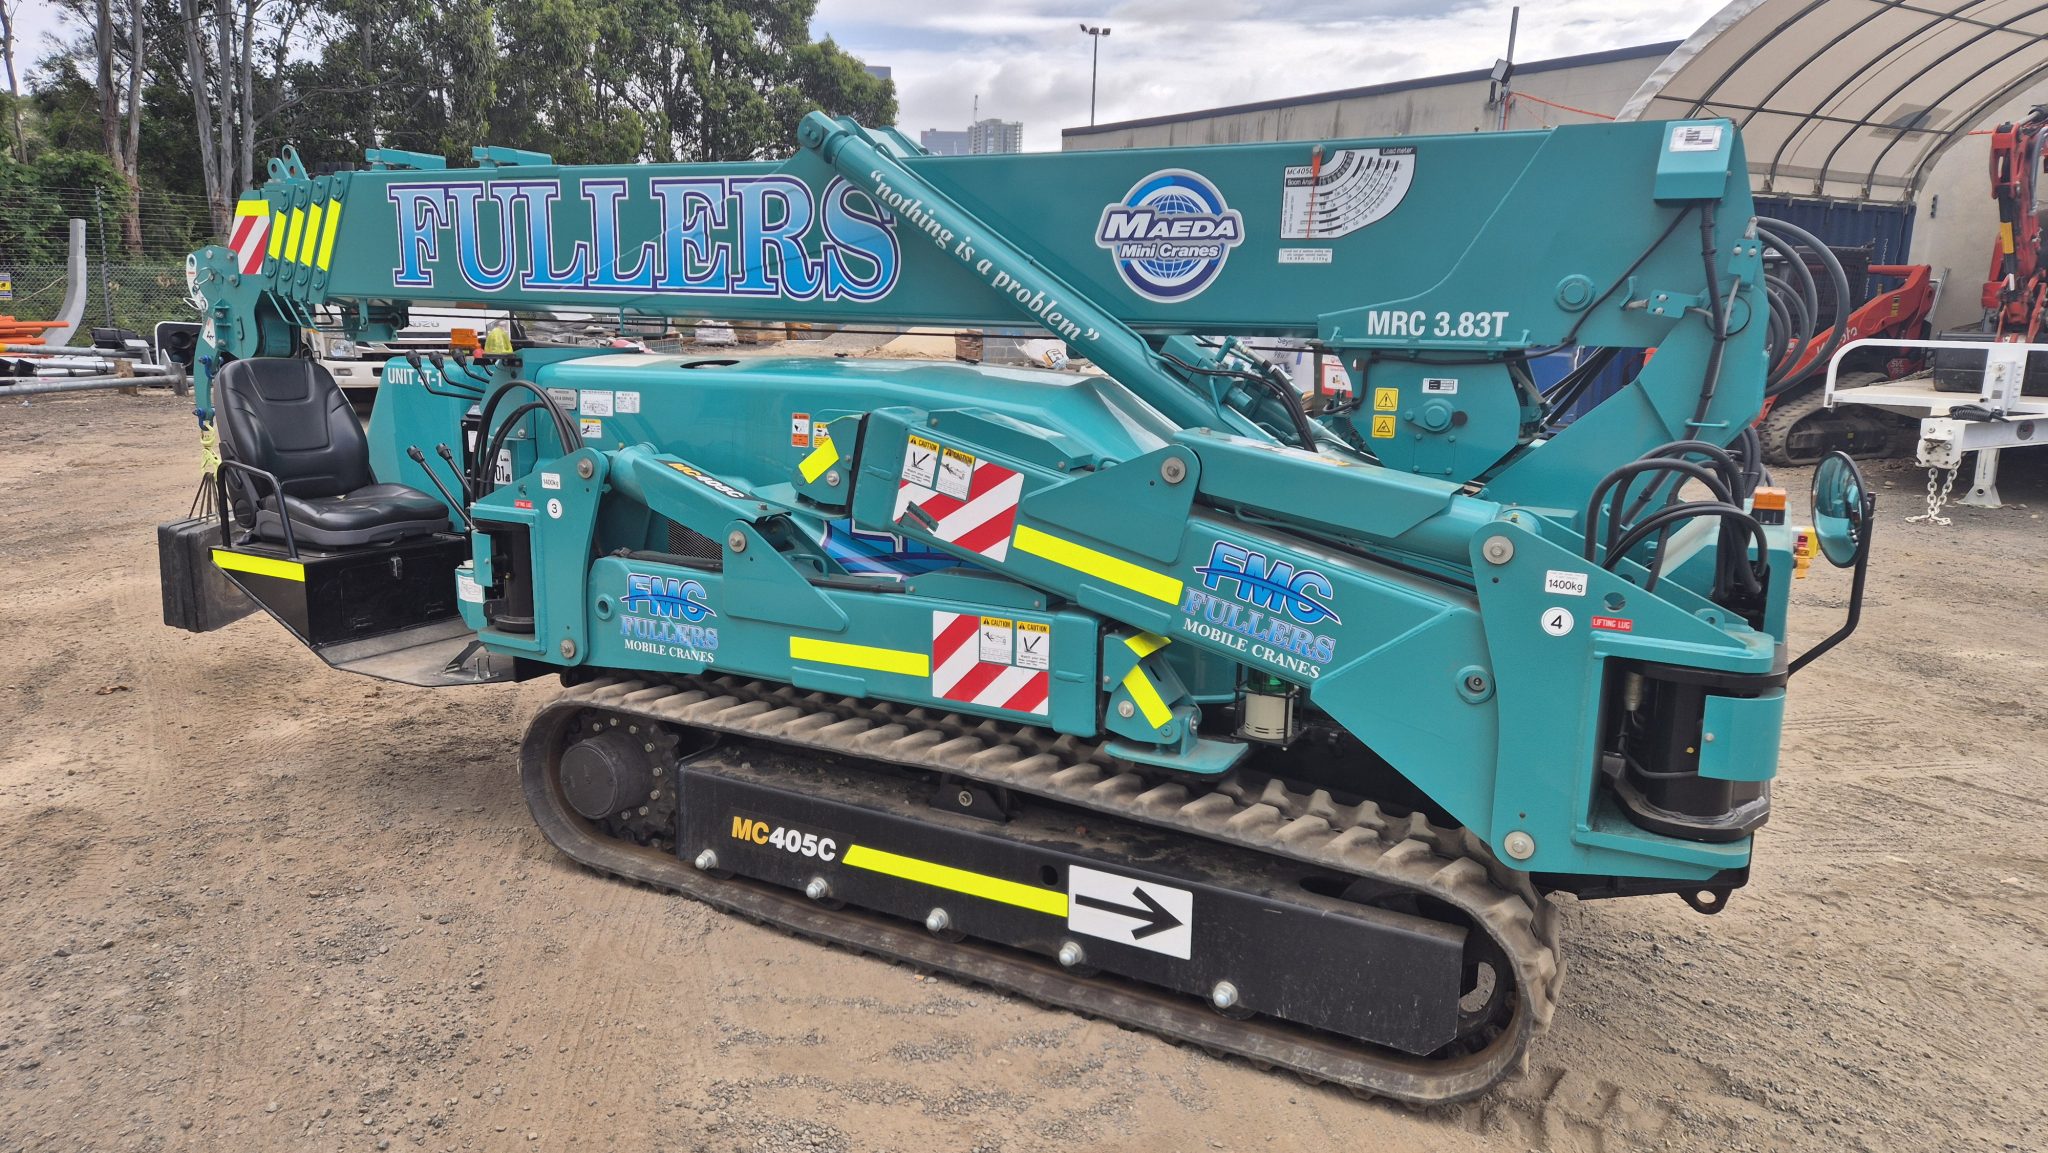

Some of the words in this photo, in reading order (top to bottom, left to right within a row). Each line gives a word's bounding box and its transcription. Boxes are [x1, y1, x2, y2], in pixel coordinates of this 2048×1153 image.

[387, 174, 902, 303] FULLERS
[1119, 243, 1156, 259] Mini
[1158, 244, 1220, 259] Cranes
[954, 236, 976, 262] is
[976, 258, 994, 276] a
[1367, 310, 1427, 336] MRC
[1433, 311, 1510, 338] 3.83T
[387, 367, 415, 385] UNIT
[495, 464, 505, 482] 01
[667, 463, 745, 498] MC405C
[551, 503, 558, 514] 3
[1202, 539, 1335, 625] FMC
[1548, 579, 1583, 593] 1400kg
[626, 572, 708, 623] FMC
[620, 615, 719, 650] FULLERS
[990, 619, 1011, 628] CAUTION
[1026, 624, 1047, 632] CAUTION
[1181, 587, 1337, 665] FULLERS
[1550, 614, 1563, 630] 4
[1592, 618, 1617, 628] LIFTING
[1617, 620, 1631, 630] LUG
[624, 639, 667, 656] MOBILE
[668, 646, 715, 663] CRANES
[1183, 617, 1249, 653] MOBILE
[1252, 644, 1321, 679] CRANES
[731, 815, 837, 862] MC405C
